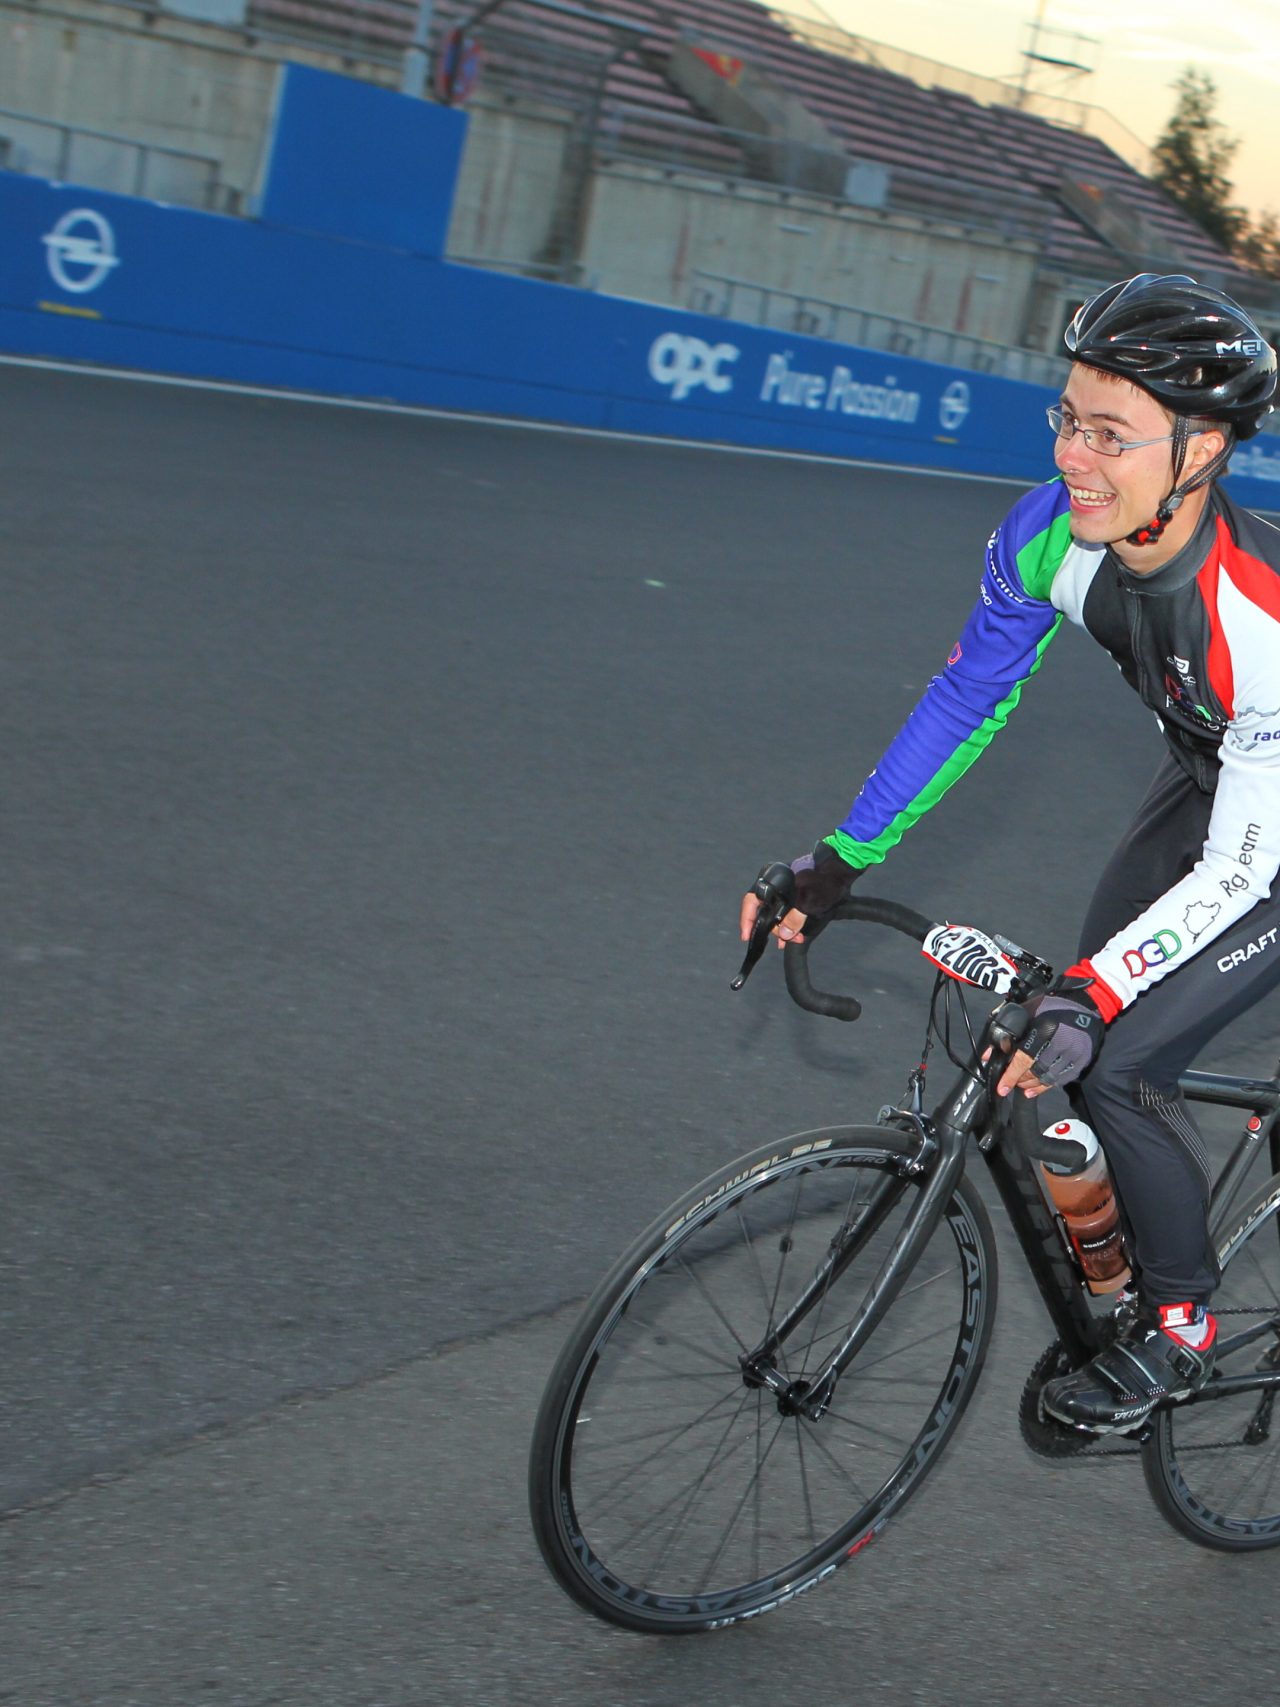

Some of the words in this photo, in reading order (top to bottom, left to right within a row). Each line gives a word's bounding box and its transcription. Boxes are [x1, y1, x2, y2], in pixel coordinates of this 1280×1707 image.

[648, 333, 739, 400] opc
[760, 353, 826, 409] Pure
[825, 365, 920, 423] Passion
[1216, 927, 1278, 974] CRAFT
[664, 1138, 833, 1240] SCHWALBE
[840, 1155, 888, 1166] AERO
[914, 1205, 982, 1466] EASTON
[571, 1534, 777, 1615] EASTON
